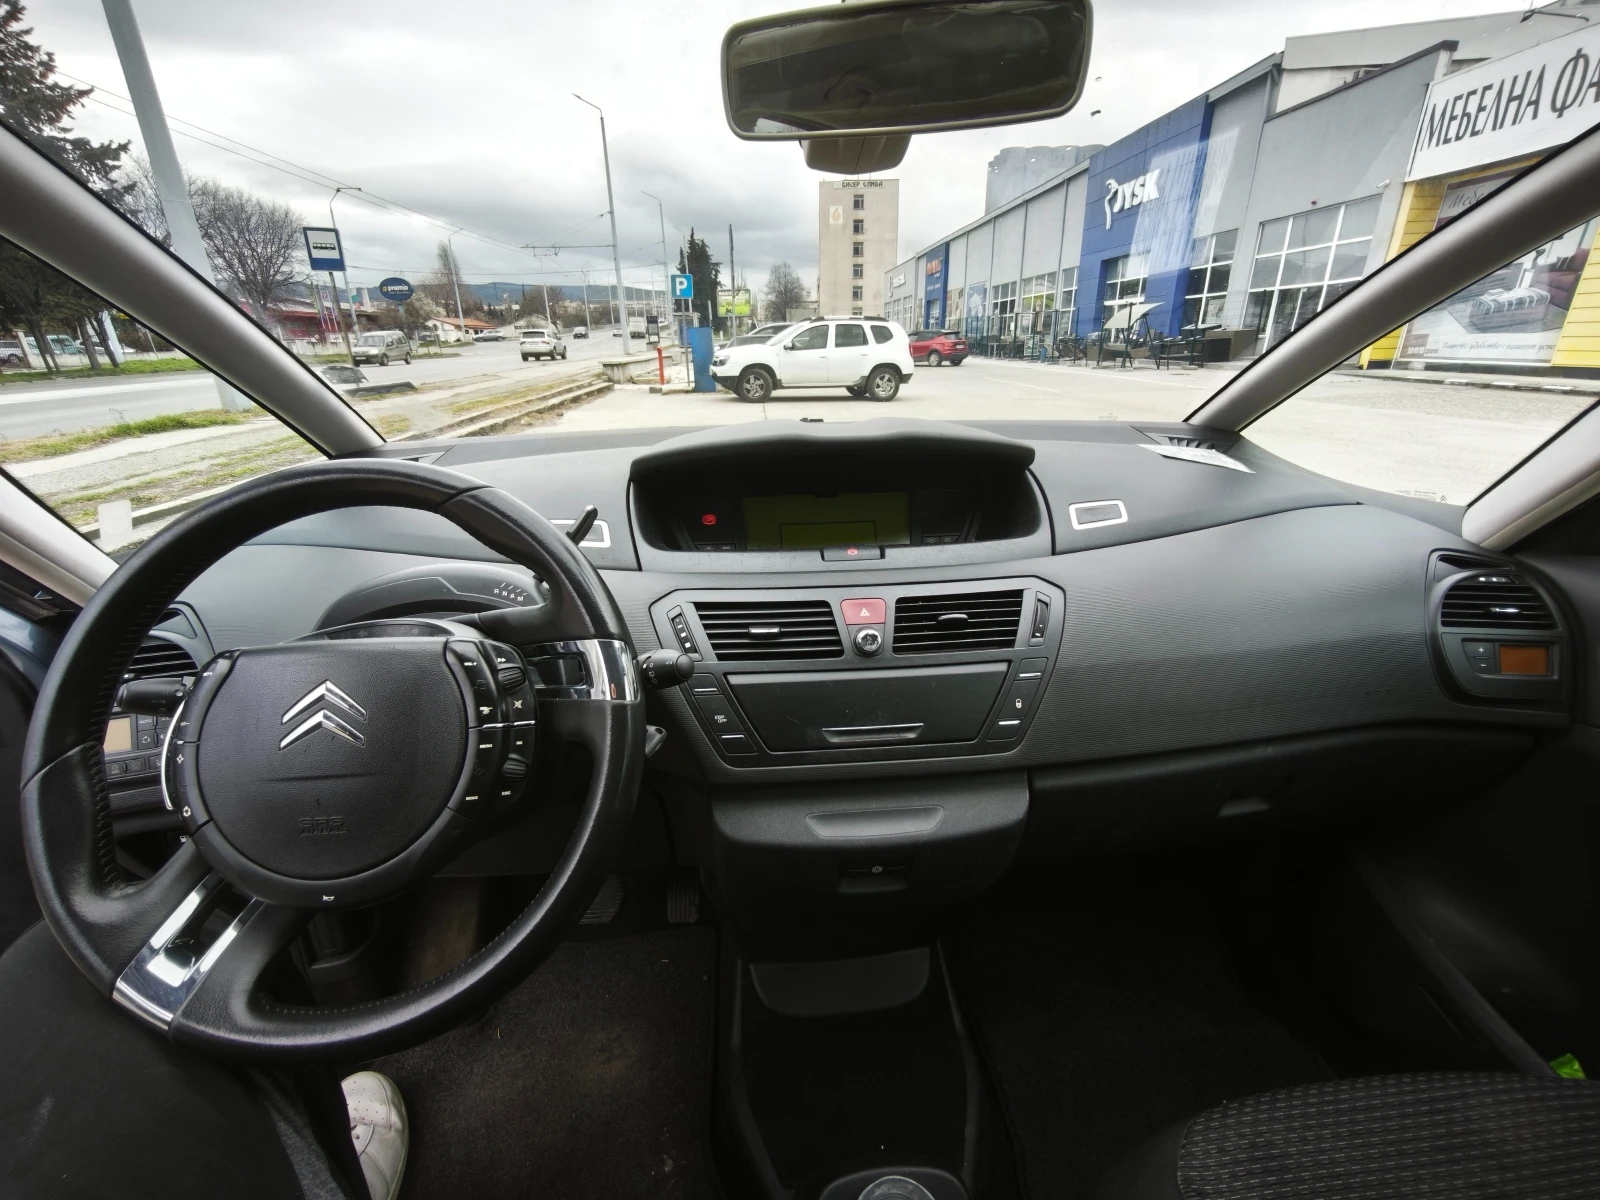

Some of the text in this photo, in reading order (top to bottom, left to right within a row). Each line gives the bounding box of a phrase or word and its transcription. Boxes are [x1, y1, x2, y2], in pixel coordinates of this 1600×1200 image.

[1419, 63, 1547, 152] МЕБЕЛНА
[1112, 168, 1160, 213] JYSK
[675, 277, 688, 296] P
